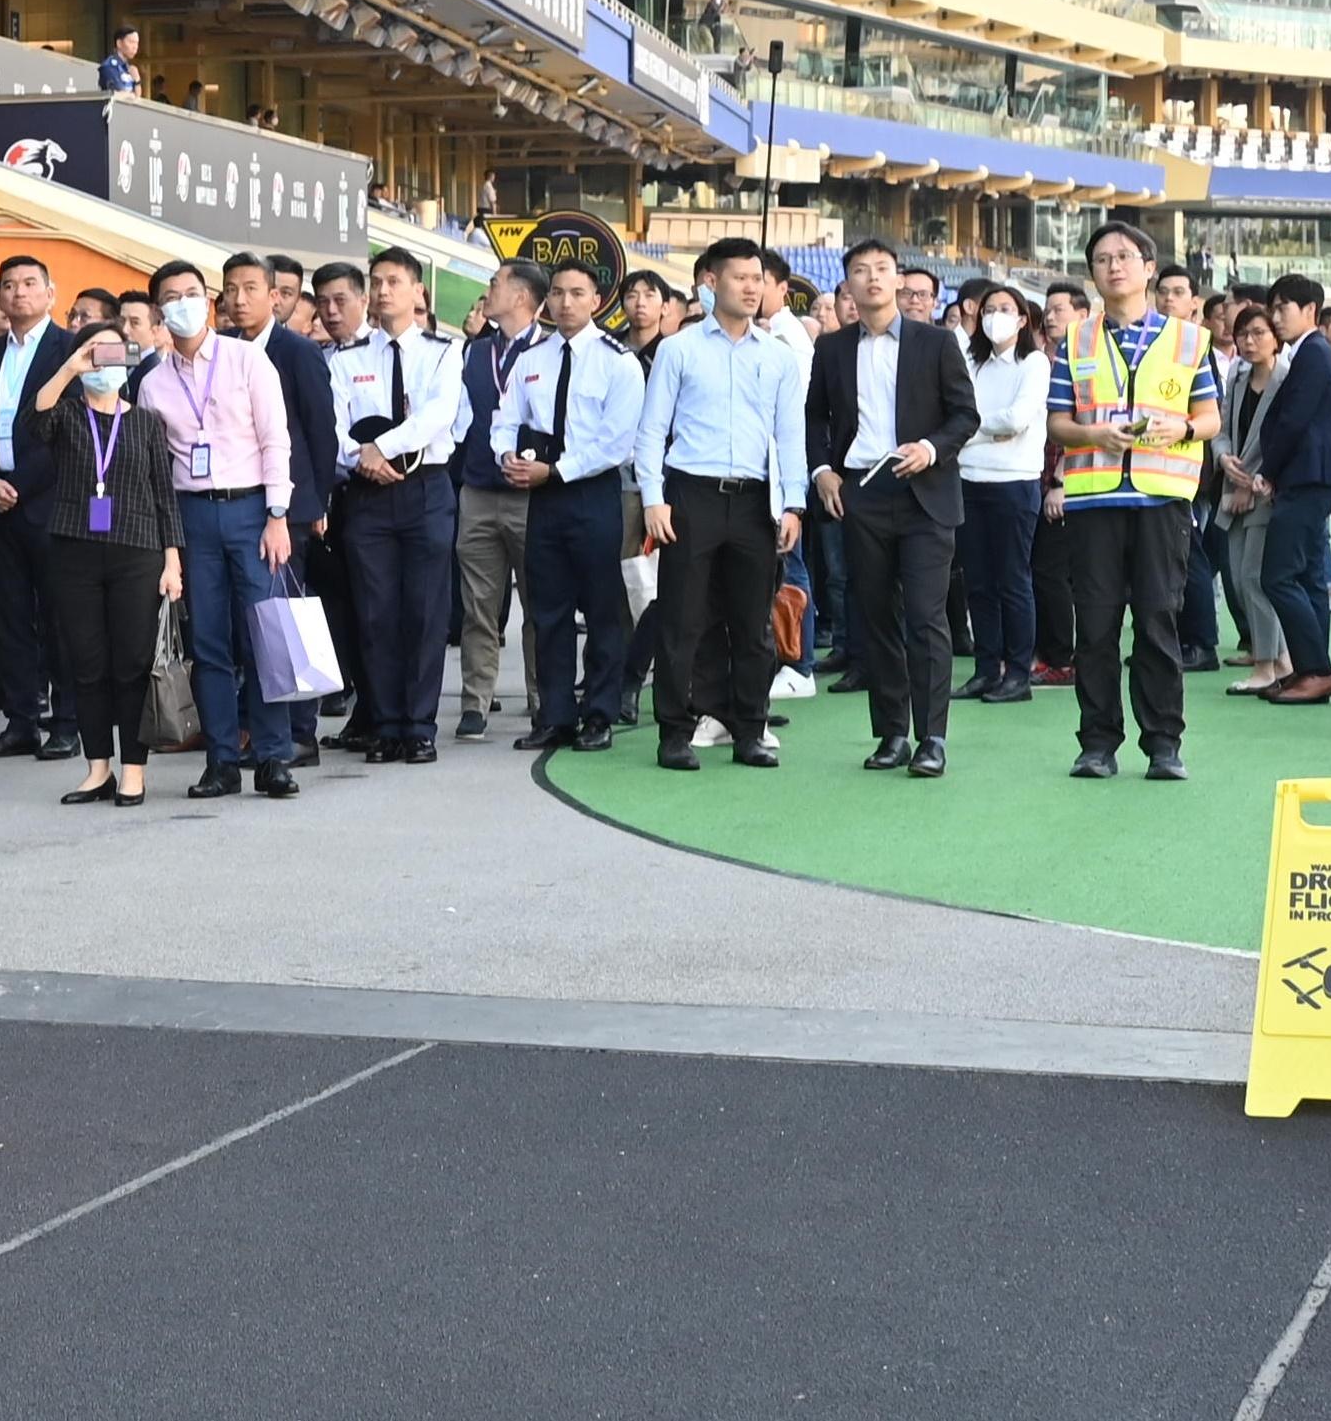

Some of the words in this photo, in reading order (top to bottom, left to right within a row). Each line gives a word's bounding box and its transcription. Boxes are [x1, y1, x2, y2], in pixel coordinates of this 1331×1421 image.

[499, 226, 523, 236] HW
[533, 237, 599, 265] BAR
[1289, 911, 1303, 920] IN
